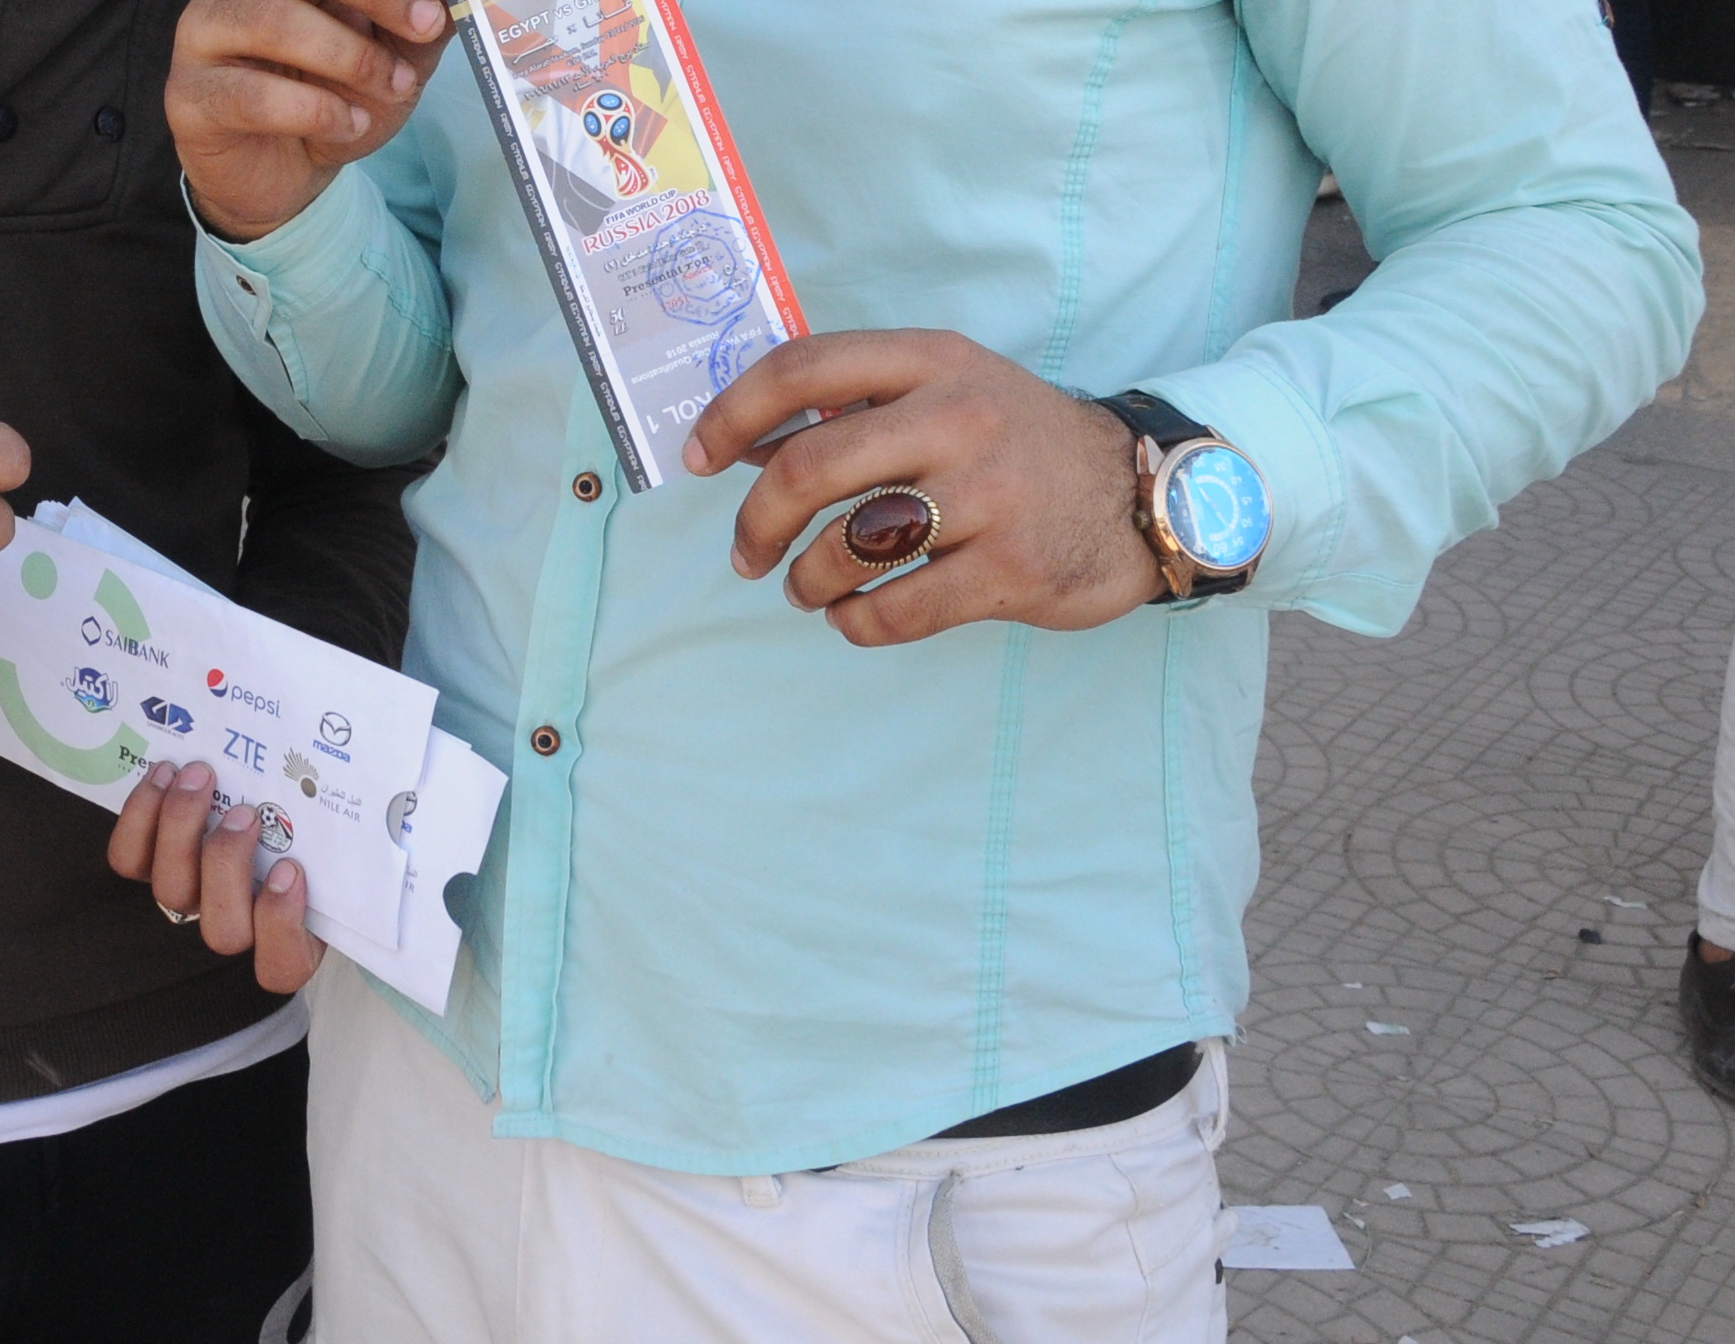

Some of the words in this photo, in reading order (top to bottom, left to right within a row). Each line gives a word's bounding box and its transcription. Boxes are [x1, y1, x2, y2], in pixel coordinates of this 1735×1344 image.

[497, 9, 552, 44] EGYPT
[553, 3, 572, 19] vs
[582, 210, 662, 253] RUSSIA
[660, 187, 711, 221] 2018
[605, 211, 626, 224] FIFA
[625, 196, 659, 216] WORLD
[658, 189, 677, 202] CUP
[687, 330, 720, 349] Russia
[630, 355, 691, 385] Qualifications
[105, 629, 170, 669] SAIBANK
[230, 684, 281, 719] pepsi
[223, 727, 267, 773] ZTE
[312, 739, 351, 764] mazda
[319, 796, 341, 814] NILE
[342, 807, 361, 823] AIR
